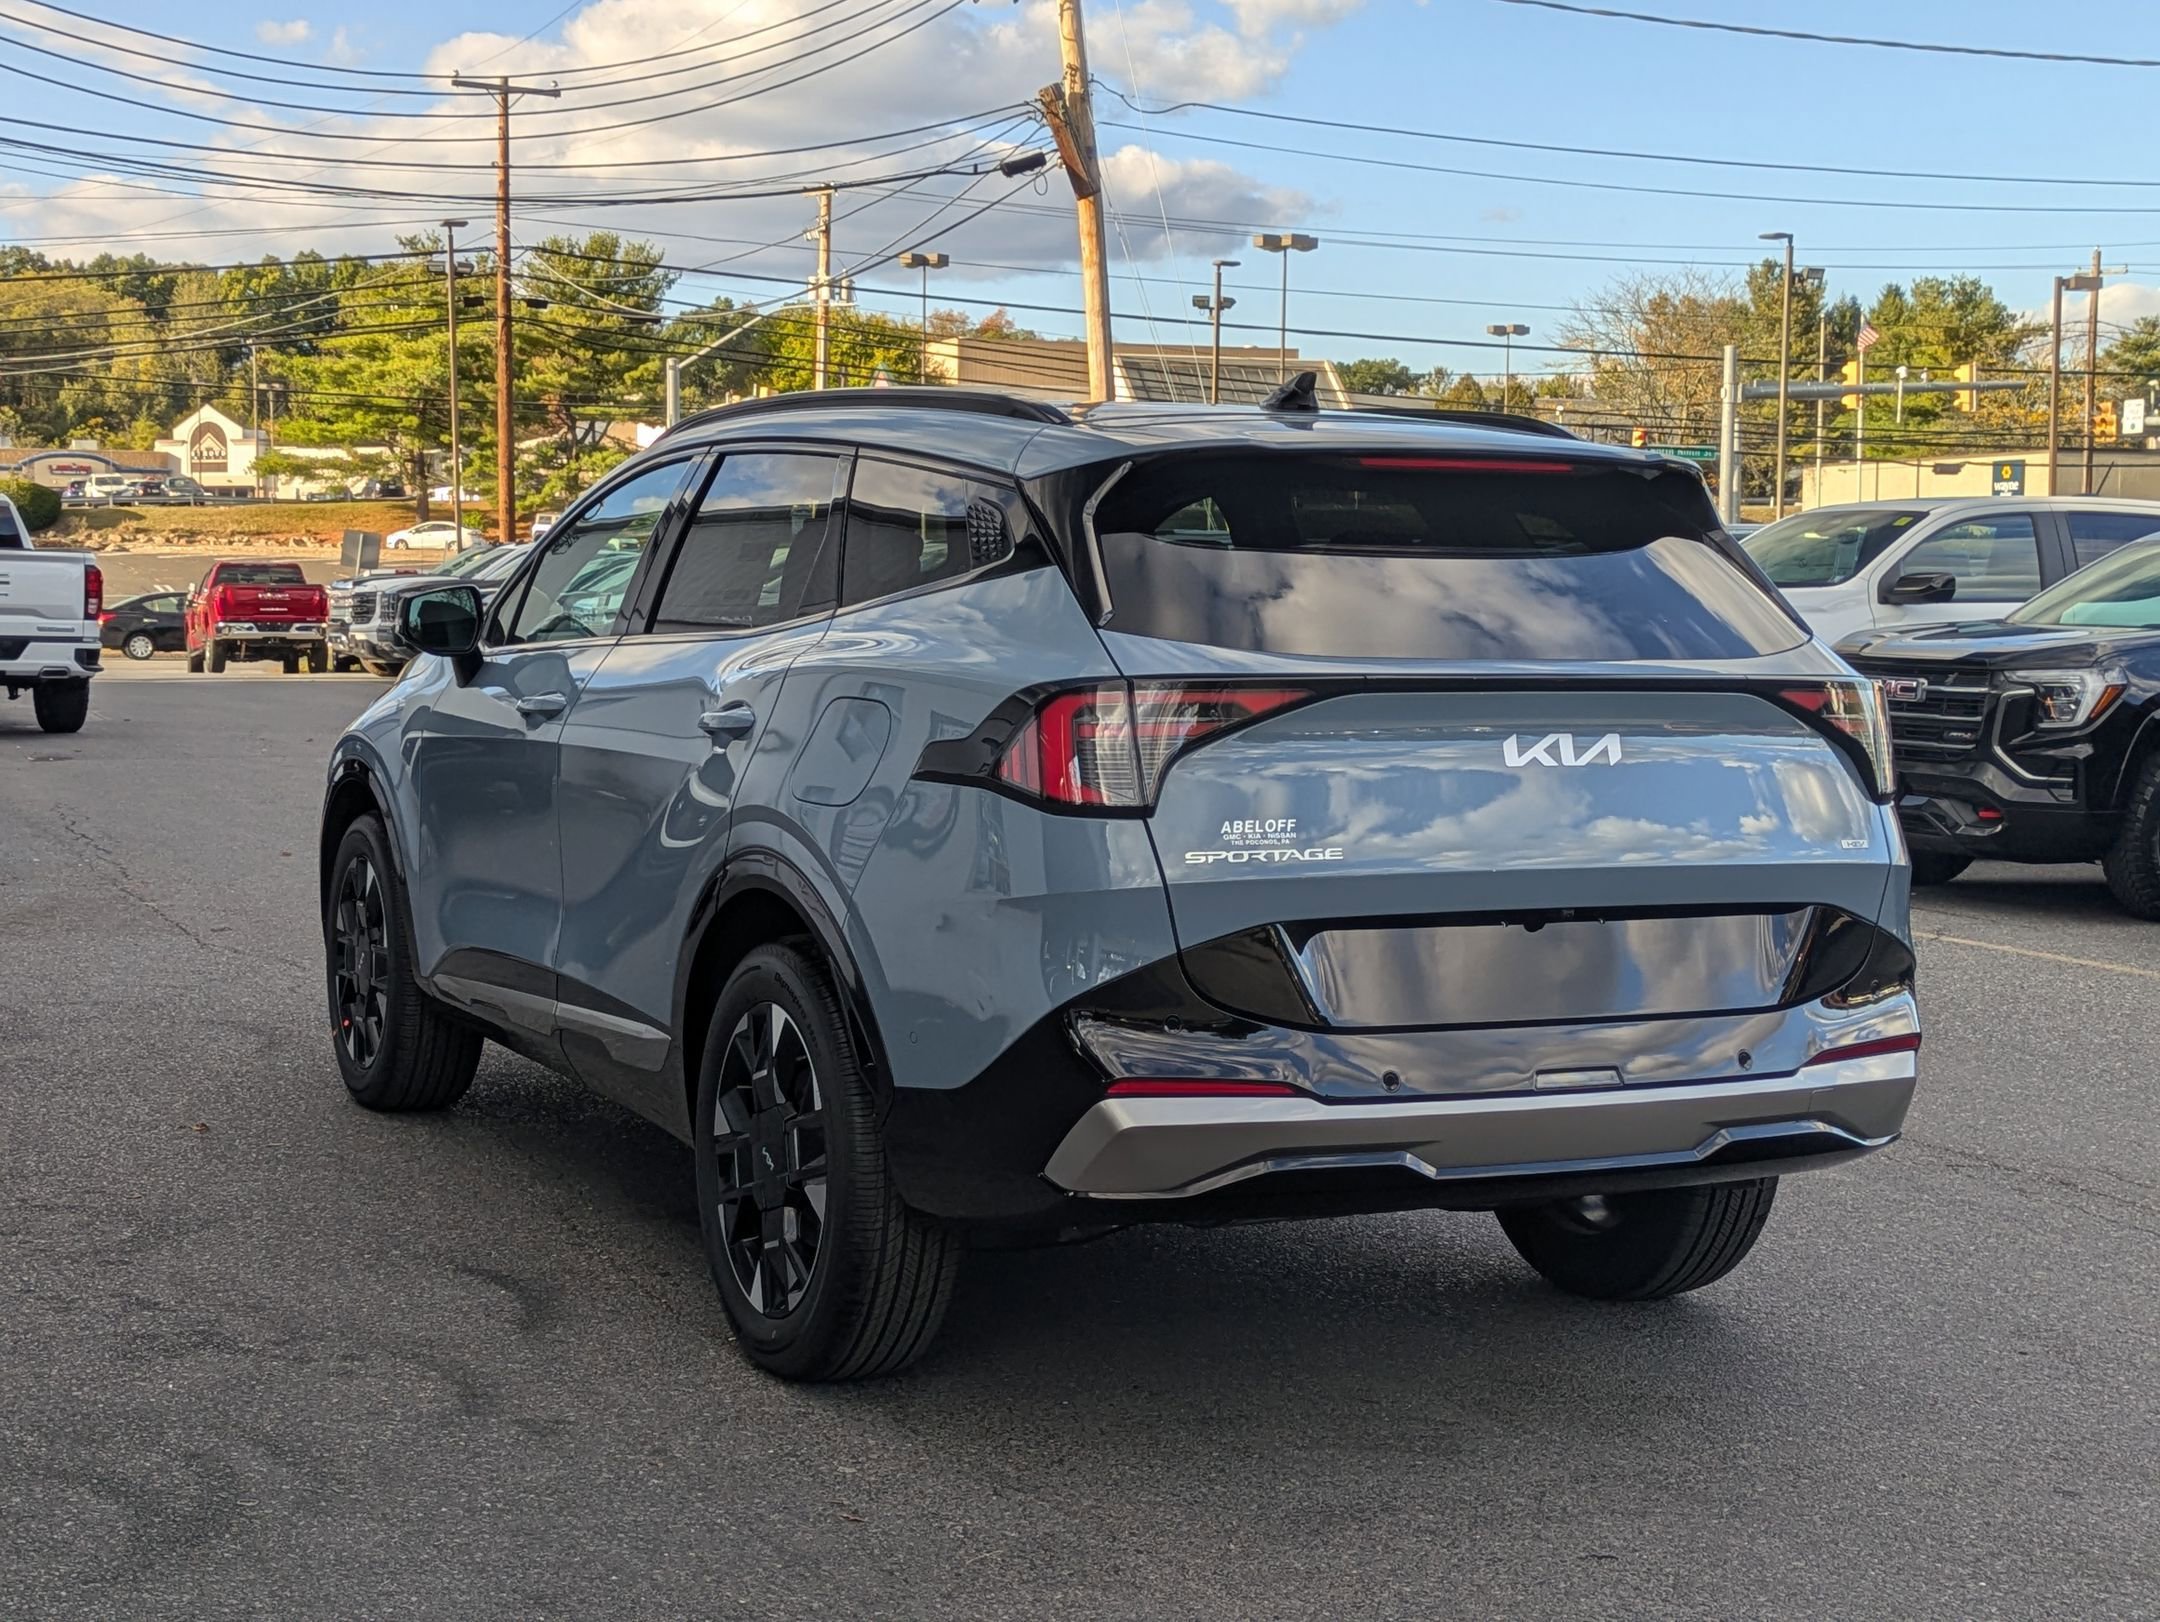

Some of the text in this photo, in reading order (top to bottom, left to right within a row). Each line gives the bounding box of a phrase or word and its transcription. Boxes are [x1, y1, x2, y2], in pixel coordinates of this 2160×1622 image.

[1994, 481, 2019, 492] wayne
[1502, 733, 1622, 767] KIA
[1220, 819, 1297, 834] ABELOFF
[1222, 833, 1242, 841] GMC
[1184, 847, 1345, 864] SPORTAGE
